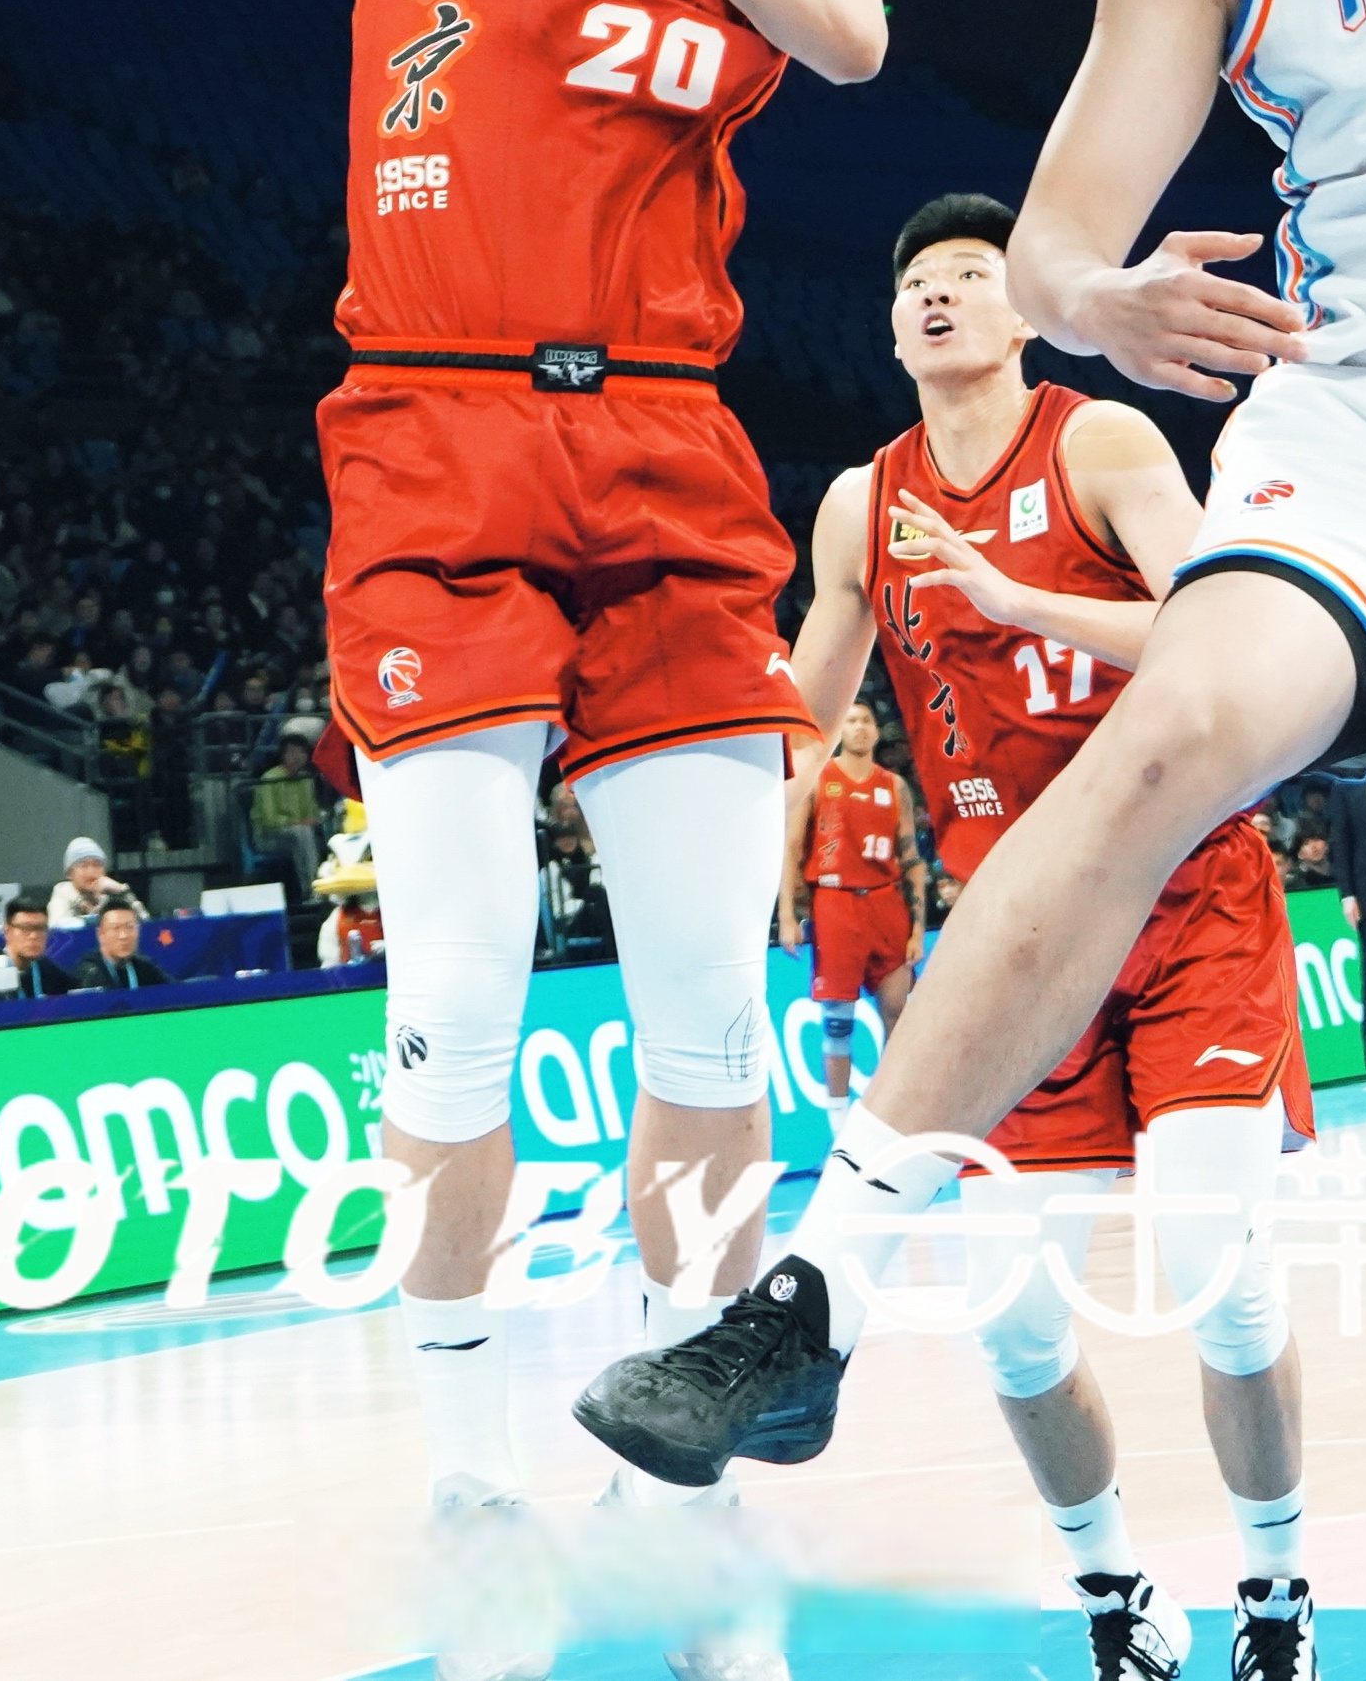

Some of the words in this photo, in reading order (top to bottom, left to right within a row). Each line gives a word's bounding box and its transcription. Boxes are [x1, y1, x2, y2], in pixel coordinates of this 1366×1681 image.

[564, 3, 727, 111] 20
[374, 154, 451, 195] 1956
[376, 190, 448, 216] SINCE
[1013, 639, 1095, 716] 17
[948, 777, 999, 806] 1956
[956, 800, 1005, 818] SINCE
